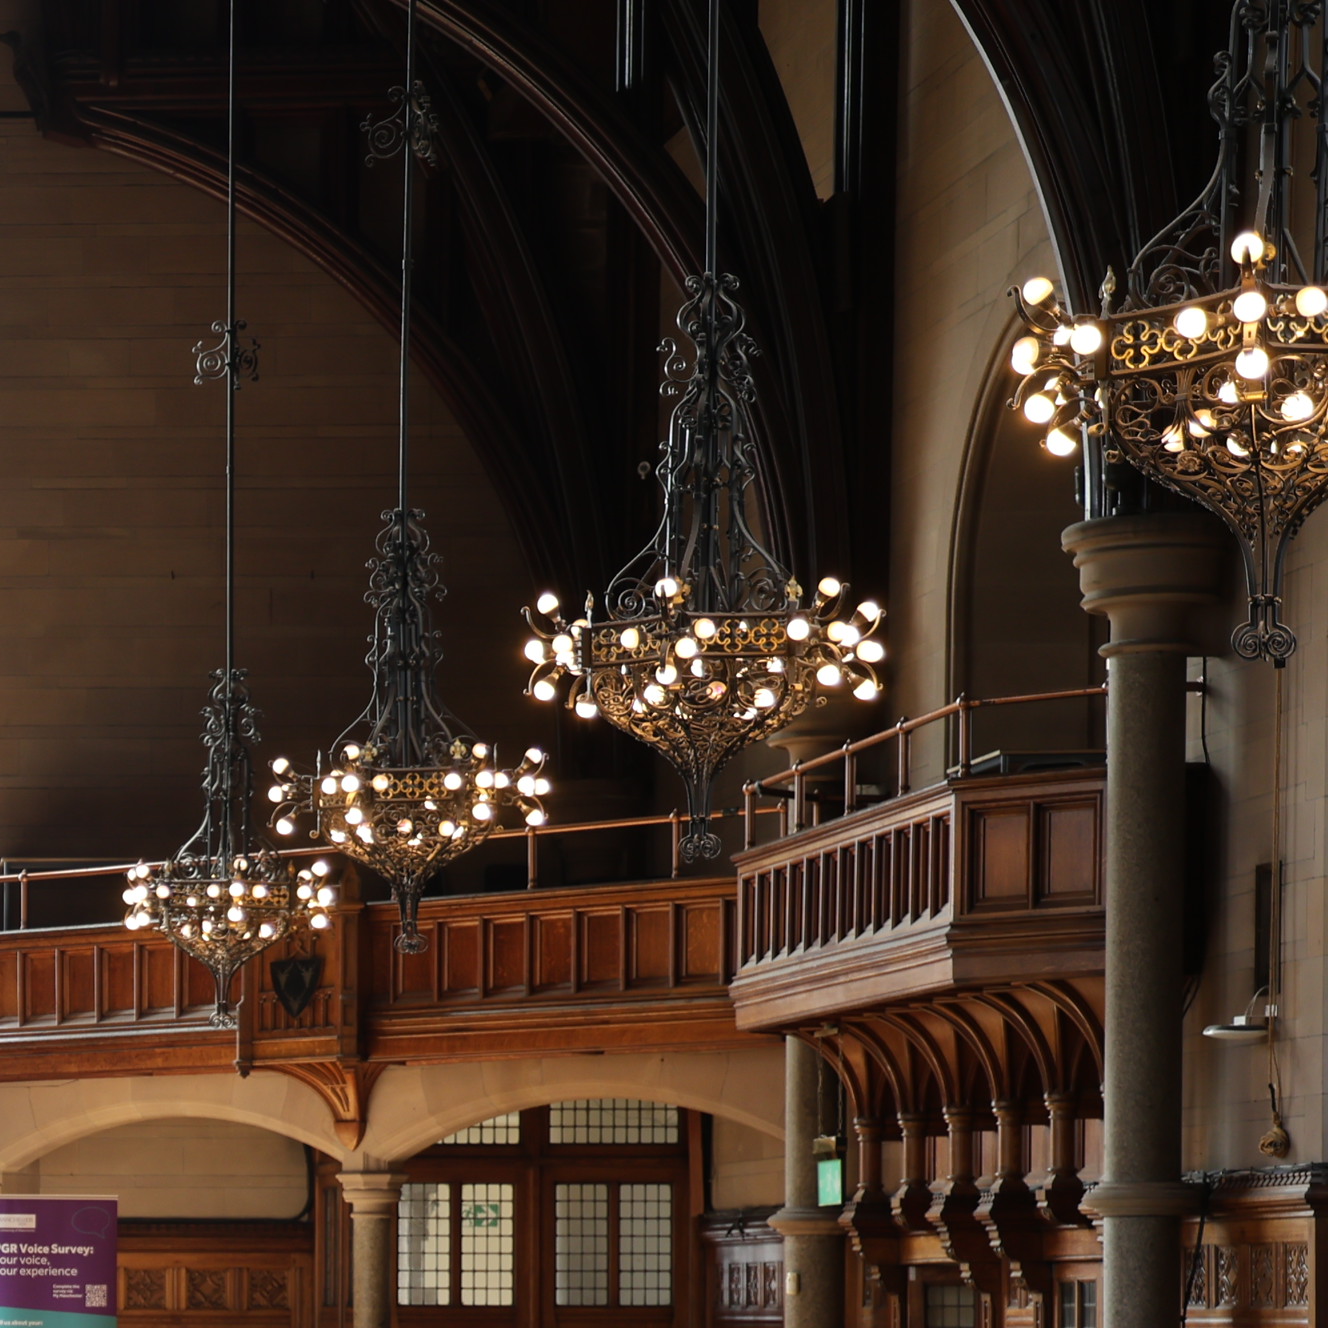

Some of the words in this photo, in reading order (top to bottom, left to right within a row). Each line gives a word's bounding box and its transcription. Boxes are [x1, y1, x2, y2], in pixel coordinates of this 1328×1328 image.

[19, 1243, 49, 1253] Voice
[51, 1244, 93, 1256] Survey:
[20, 1255, 50, 1265] voice,
[20, 1267, 77, 1277] experience
